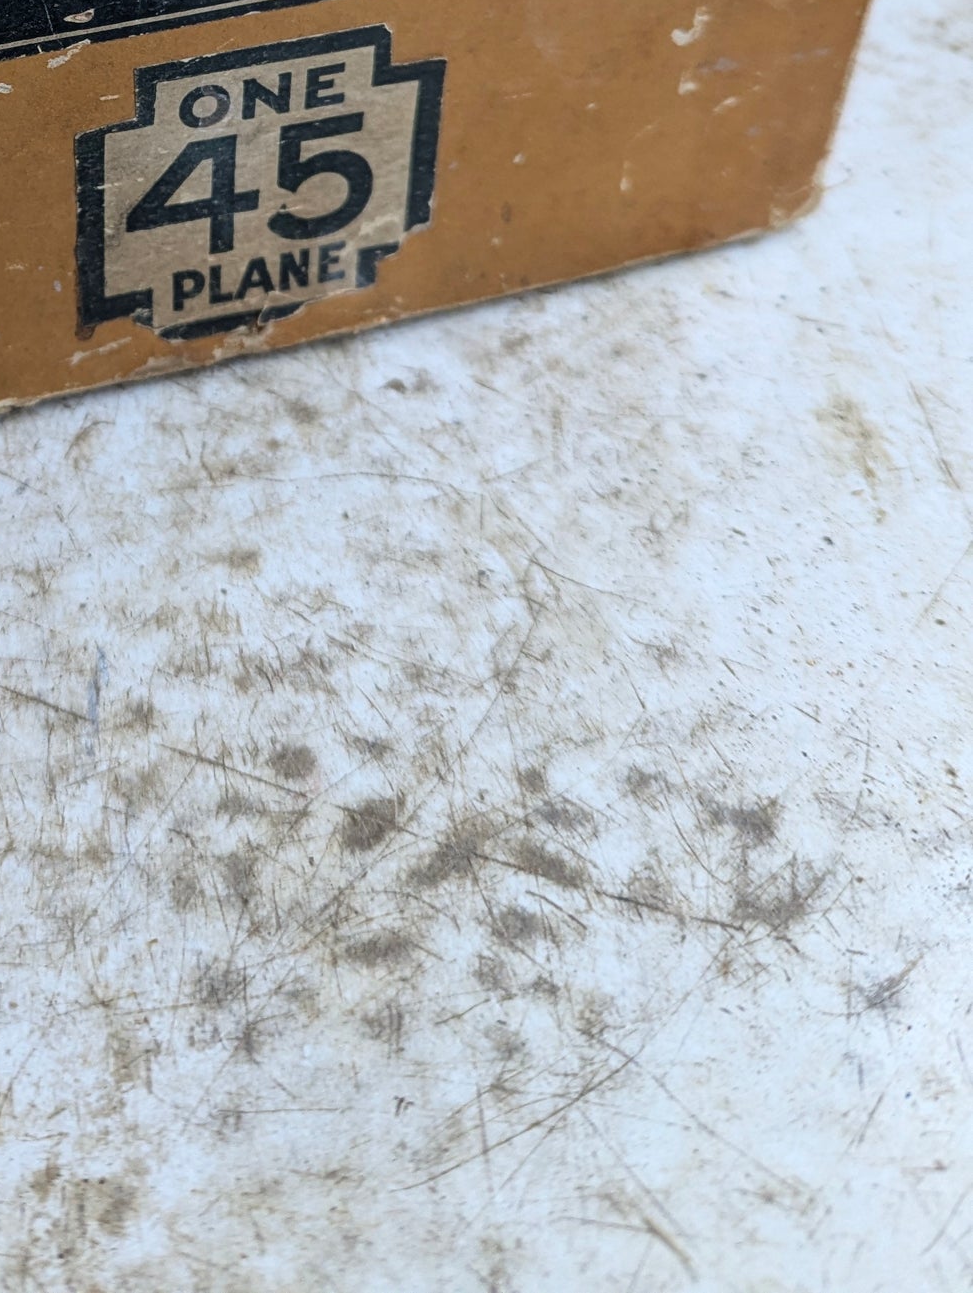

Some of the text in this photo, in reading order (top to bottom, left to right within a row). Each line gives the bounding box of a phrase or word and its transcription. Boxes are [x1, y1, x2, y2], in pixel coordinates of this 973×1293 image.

[178, 62, 346, 128] ONE
[126, 111, 373, 255] 45
[172, 240, 347, 312] PLANE
